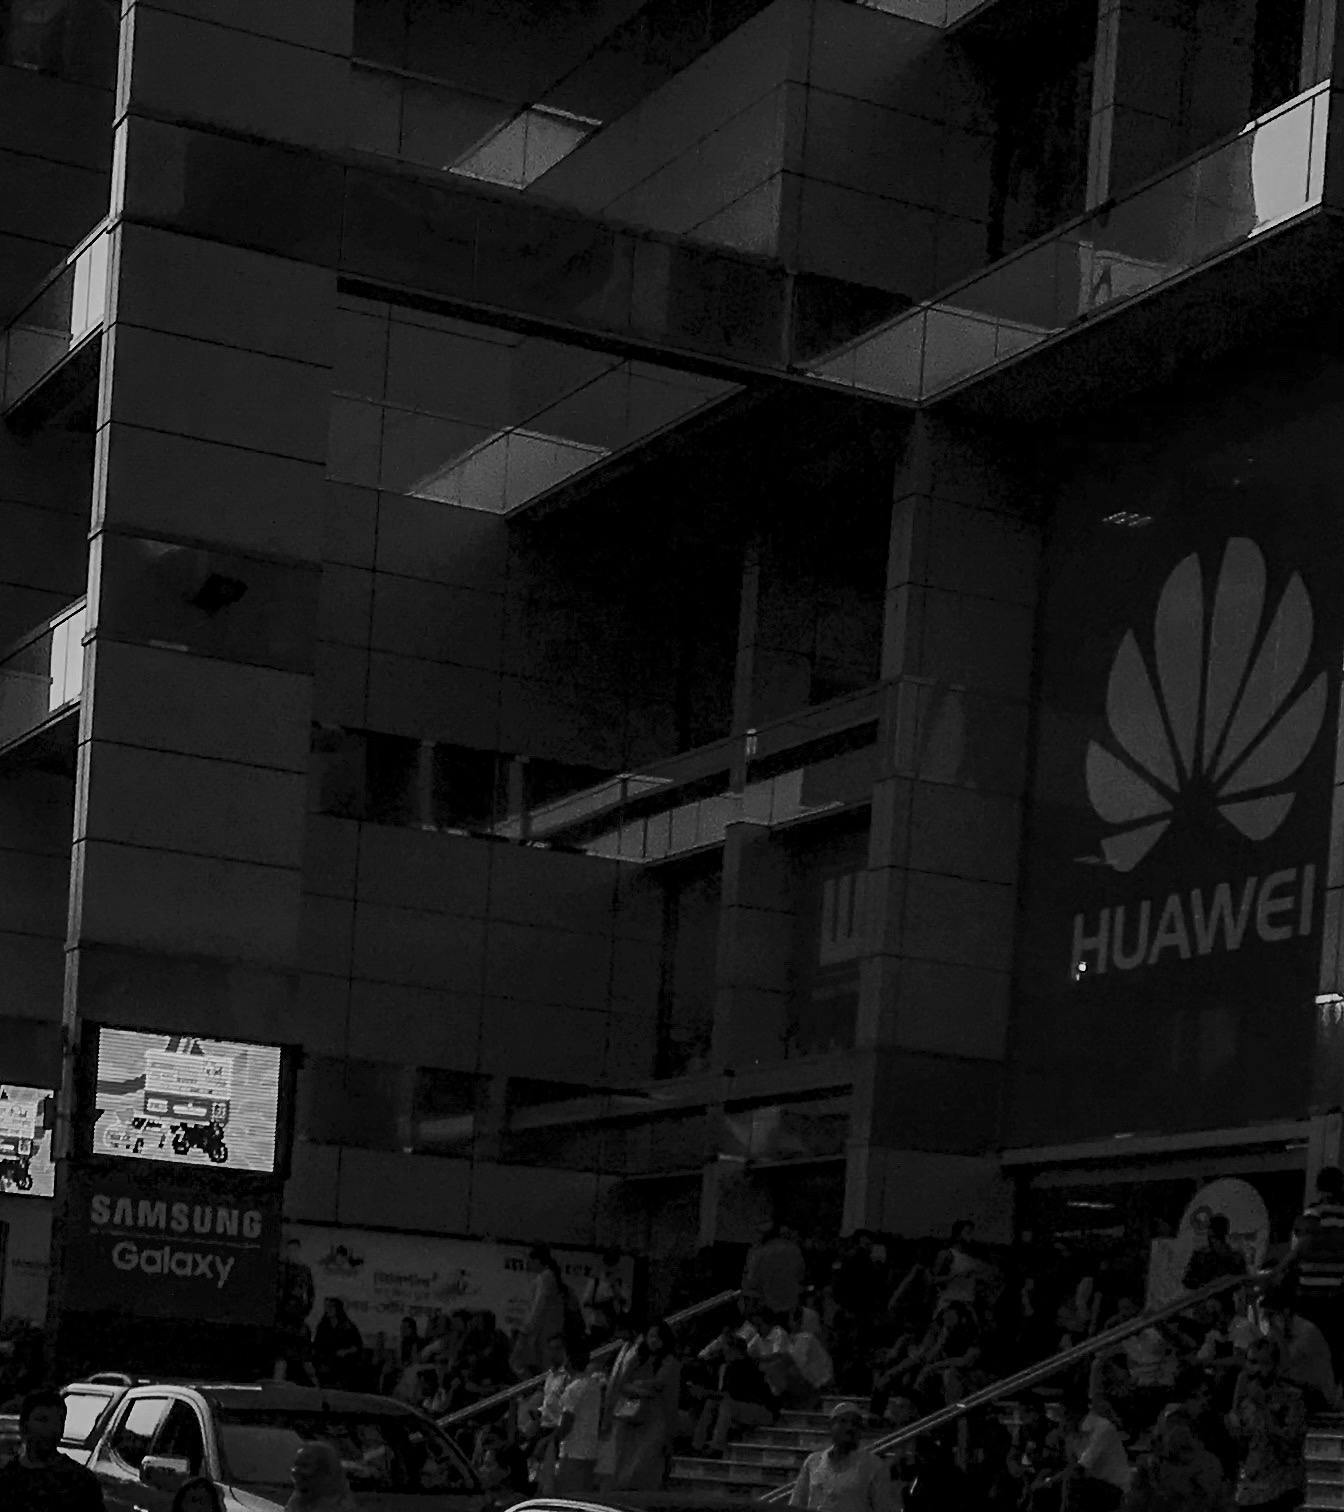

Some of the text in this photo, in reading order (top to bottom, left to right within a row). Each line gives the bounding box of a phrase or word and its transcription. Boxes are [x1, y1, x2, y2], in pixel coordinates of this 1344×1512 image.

[1070, 863, 1315, 981] HUAWEI
[90, 1193, 262, 1238] SAMSUNG
[111, 1240, 235, 1289] Galaxy
